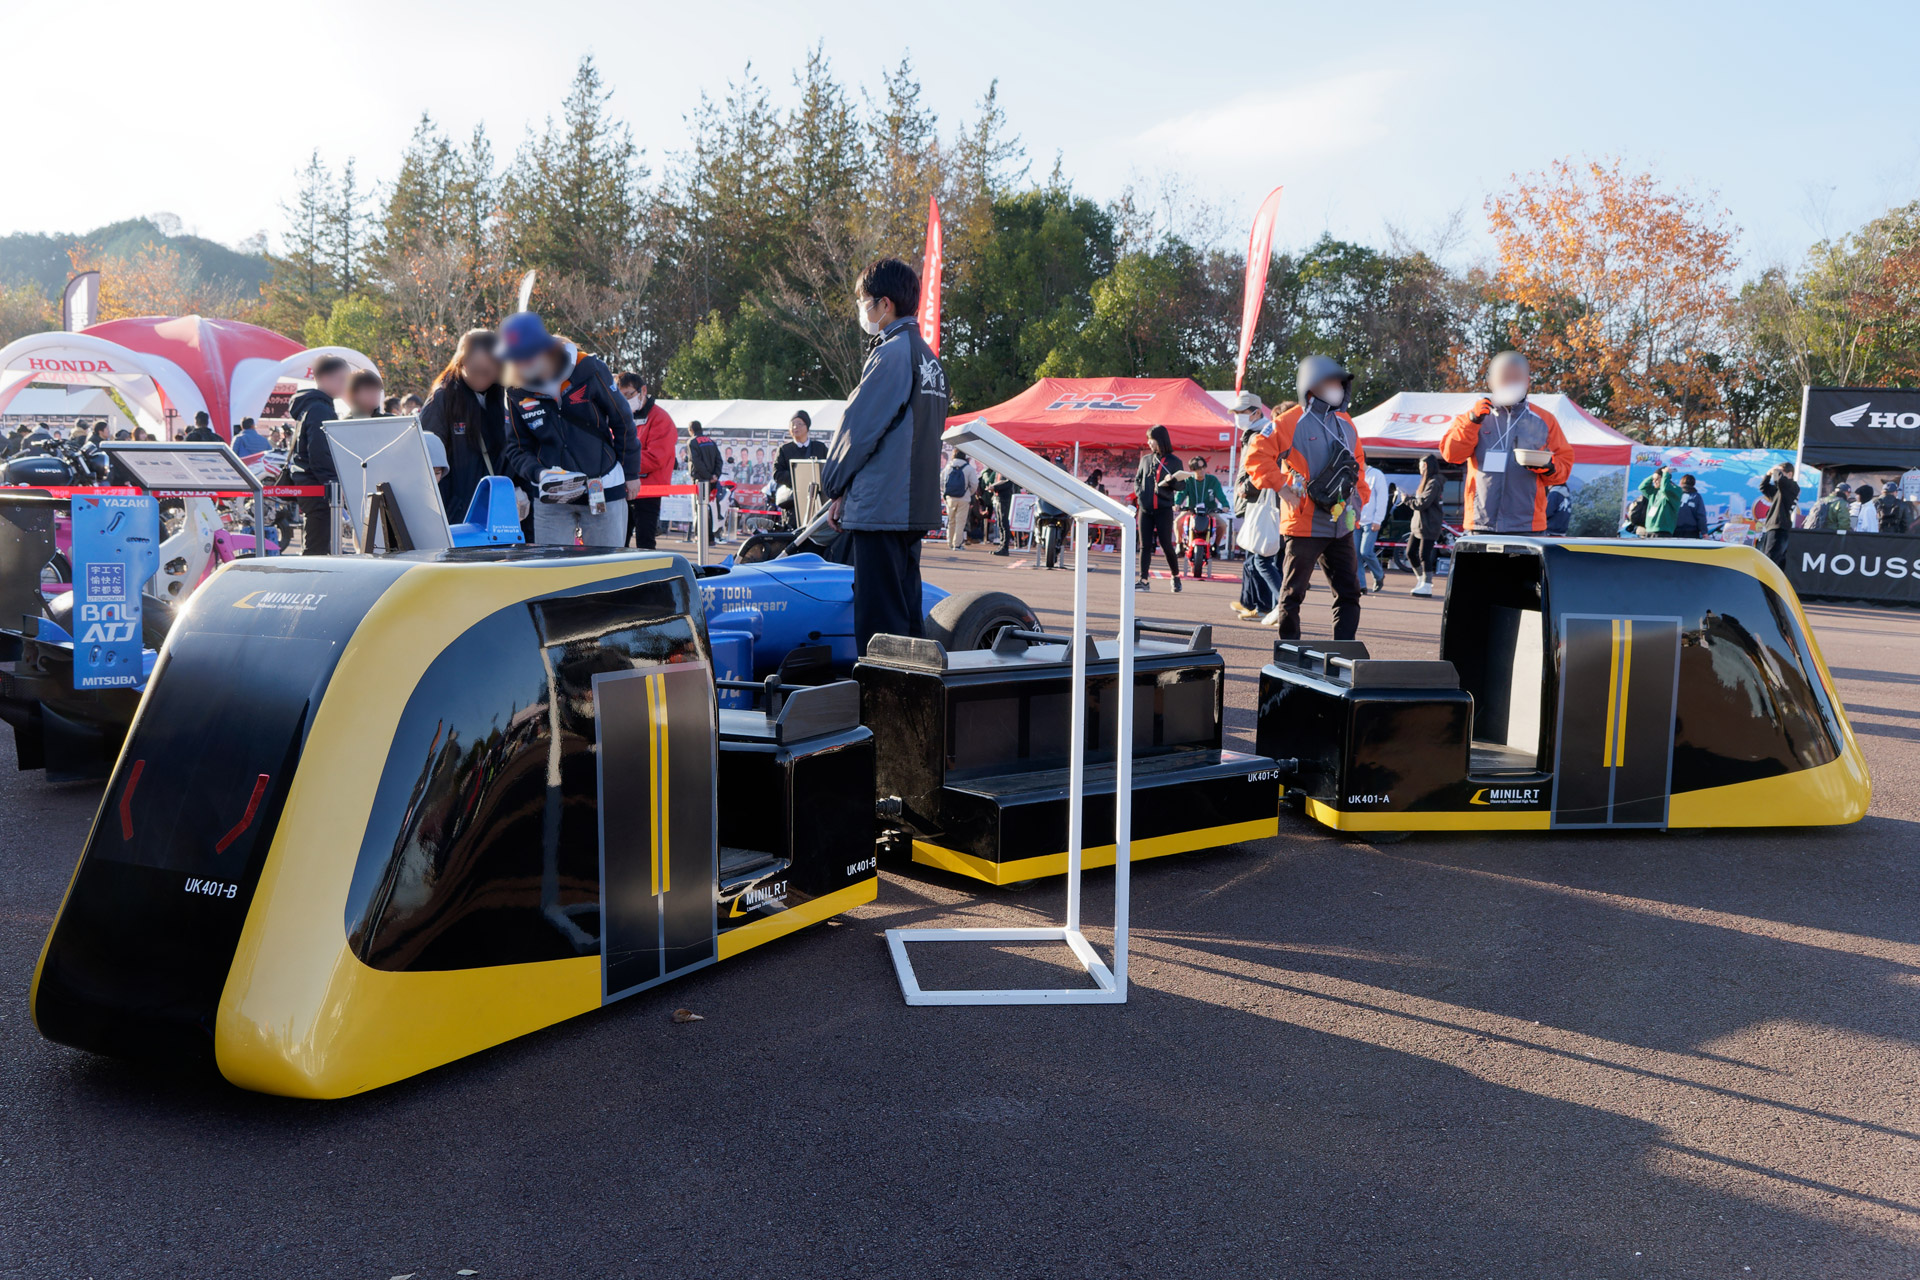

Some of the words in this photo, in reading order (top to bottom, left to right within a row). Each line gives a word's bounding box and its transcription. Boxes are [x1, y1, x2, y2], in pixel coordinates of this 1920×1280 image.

[28, 358, 115, 372] HONDA
[1045, 393, 1155, 411] HRC
[274, 488, 303, 496] College
[102, 499, 149, 508] YAZAKI
[91, 576, 121, 584] 愉快だ
[91, 586, 121, 594] 宇都宮
[722, 587, 752, 600] 100th
[260, 592, 327, 605] MINILRT
[722, 600, 788, 612] anniversary
[81, 604, 137, 621] BAL
[81, 623, 136, 643] ATJ
[82, 676, 137, 686] MITSUBA
[1248, 771, 1279, 782] UK401-C
[1348, 795, 1390, 804] UK401-A
[1490, 789, 1540, 799] MINILRT
[847, 856, 876, 876] UK401-B
[185, 878, 238, 899] UK401-B
[746, 880, 788, 906] MINILRT
